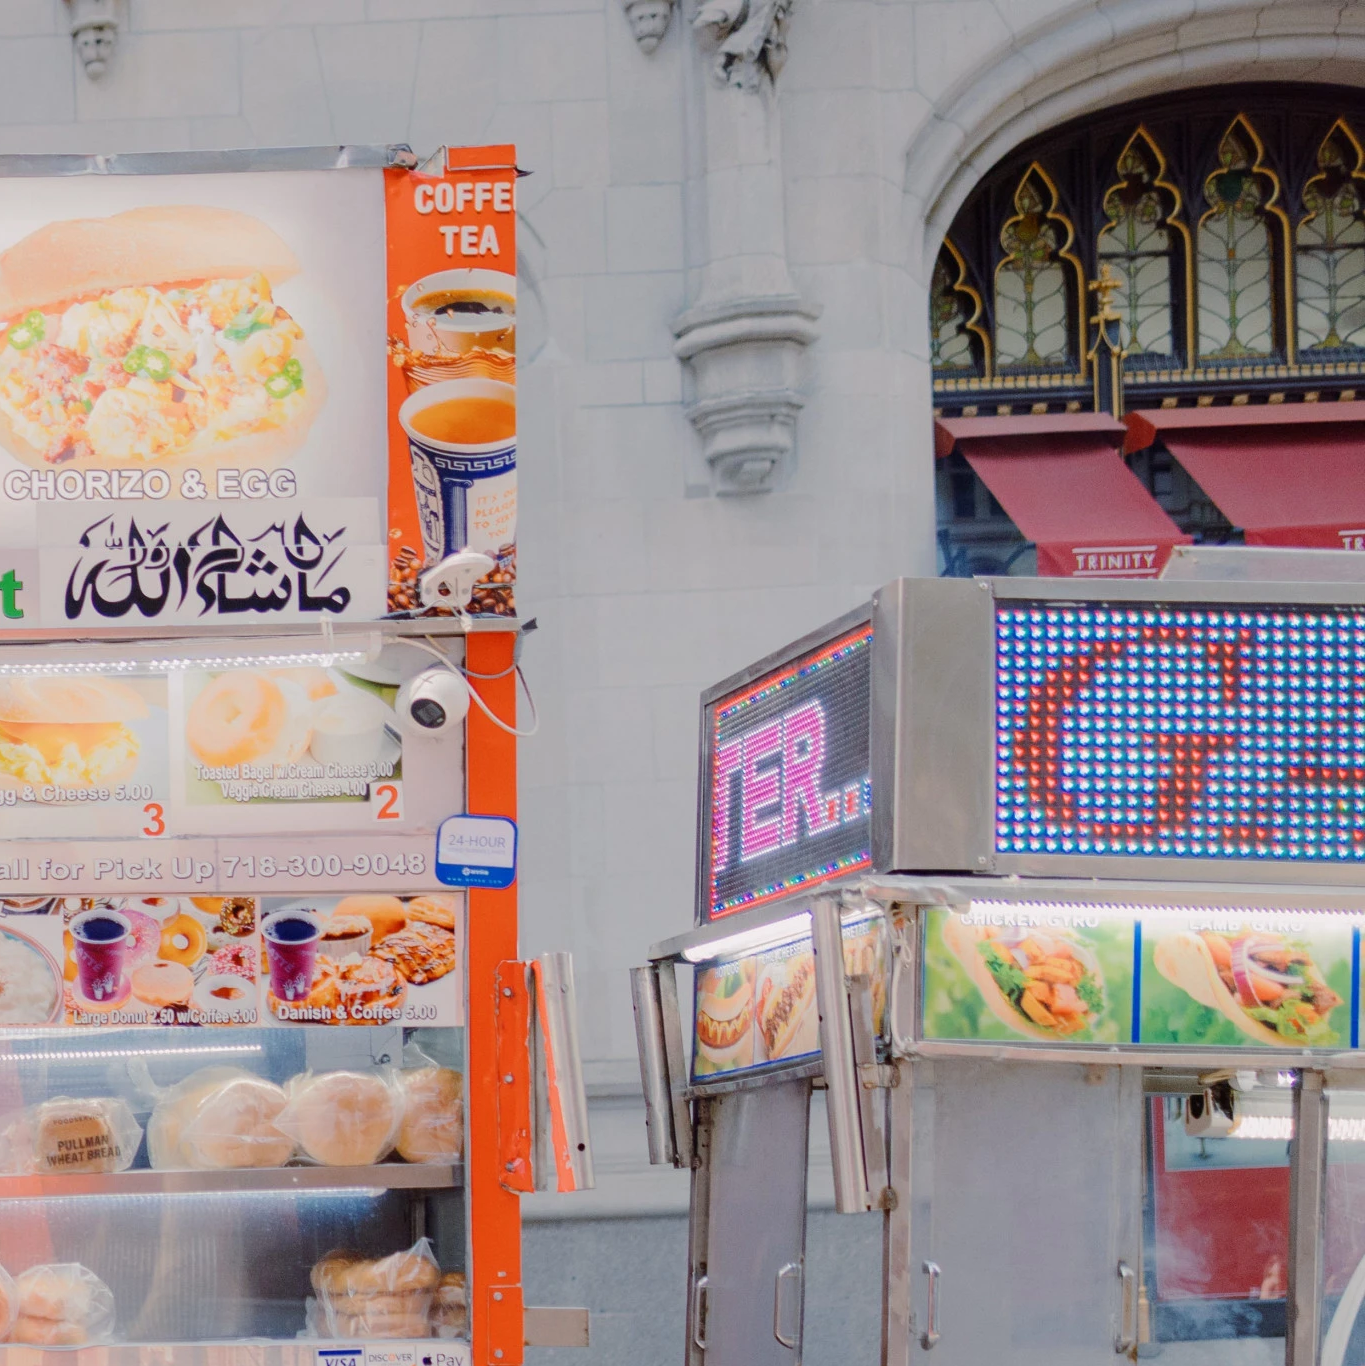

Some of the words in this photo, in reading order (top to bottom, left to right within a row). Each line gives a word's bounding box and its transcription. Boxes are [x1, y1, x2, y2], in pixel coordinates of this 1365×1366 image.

[413, 182, 516, 216] COFFE
[439, 224, 499, 257] TEA
[2, 468, 170, 500] CHORIZO
[180, 468, 209, 499] &
[216, 467, 298, 499] EGG
[1076, 553, 1156, 570] TRINITY
[375, 784, 401, 820] 2
[142, 802, 166, 837] 3
[447, 834, 507, 850] 24-HOUR
[38, 857, 84, 881] for
[93, 856, 162, 881] Pick
[171, 856, 214, 884] Up
[222, 852, 426, 880] 718-300-9048
[277, 1005, 332, 1021] Danish
[335, 1005, 348, 1020] &
[350, 1005, 401, 1021] Coffee
[404, 1004, 437, 1020] 5.00
[46, 1150, 85, 1167] WHEAT
[86, 1145, 122, 1161] BREAD
[57, 1134, 109, 1152] PULLMAN
[369, 1353, 413, 1363] DISCOVER
